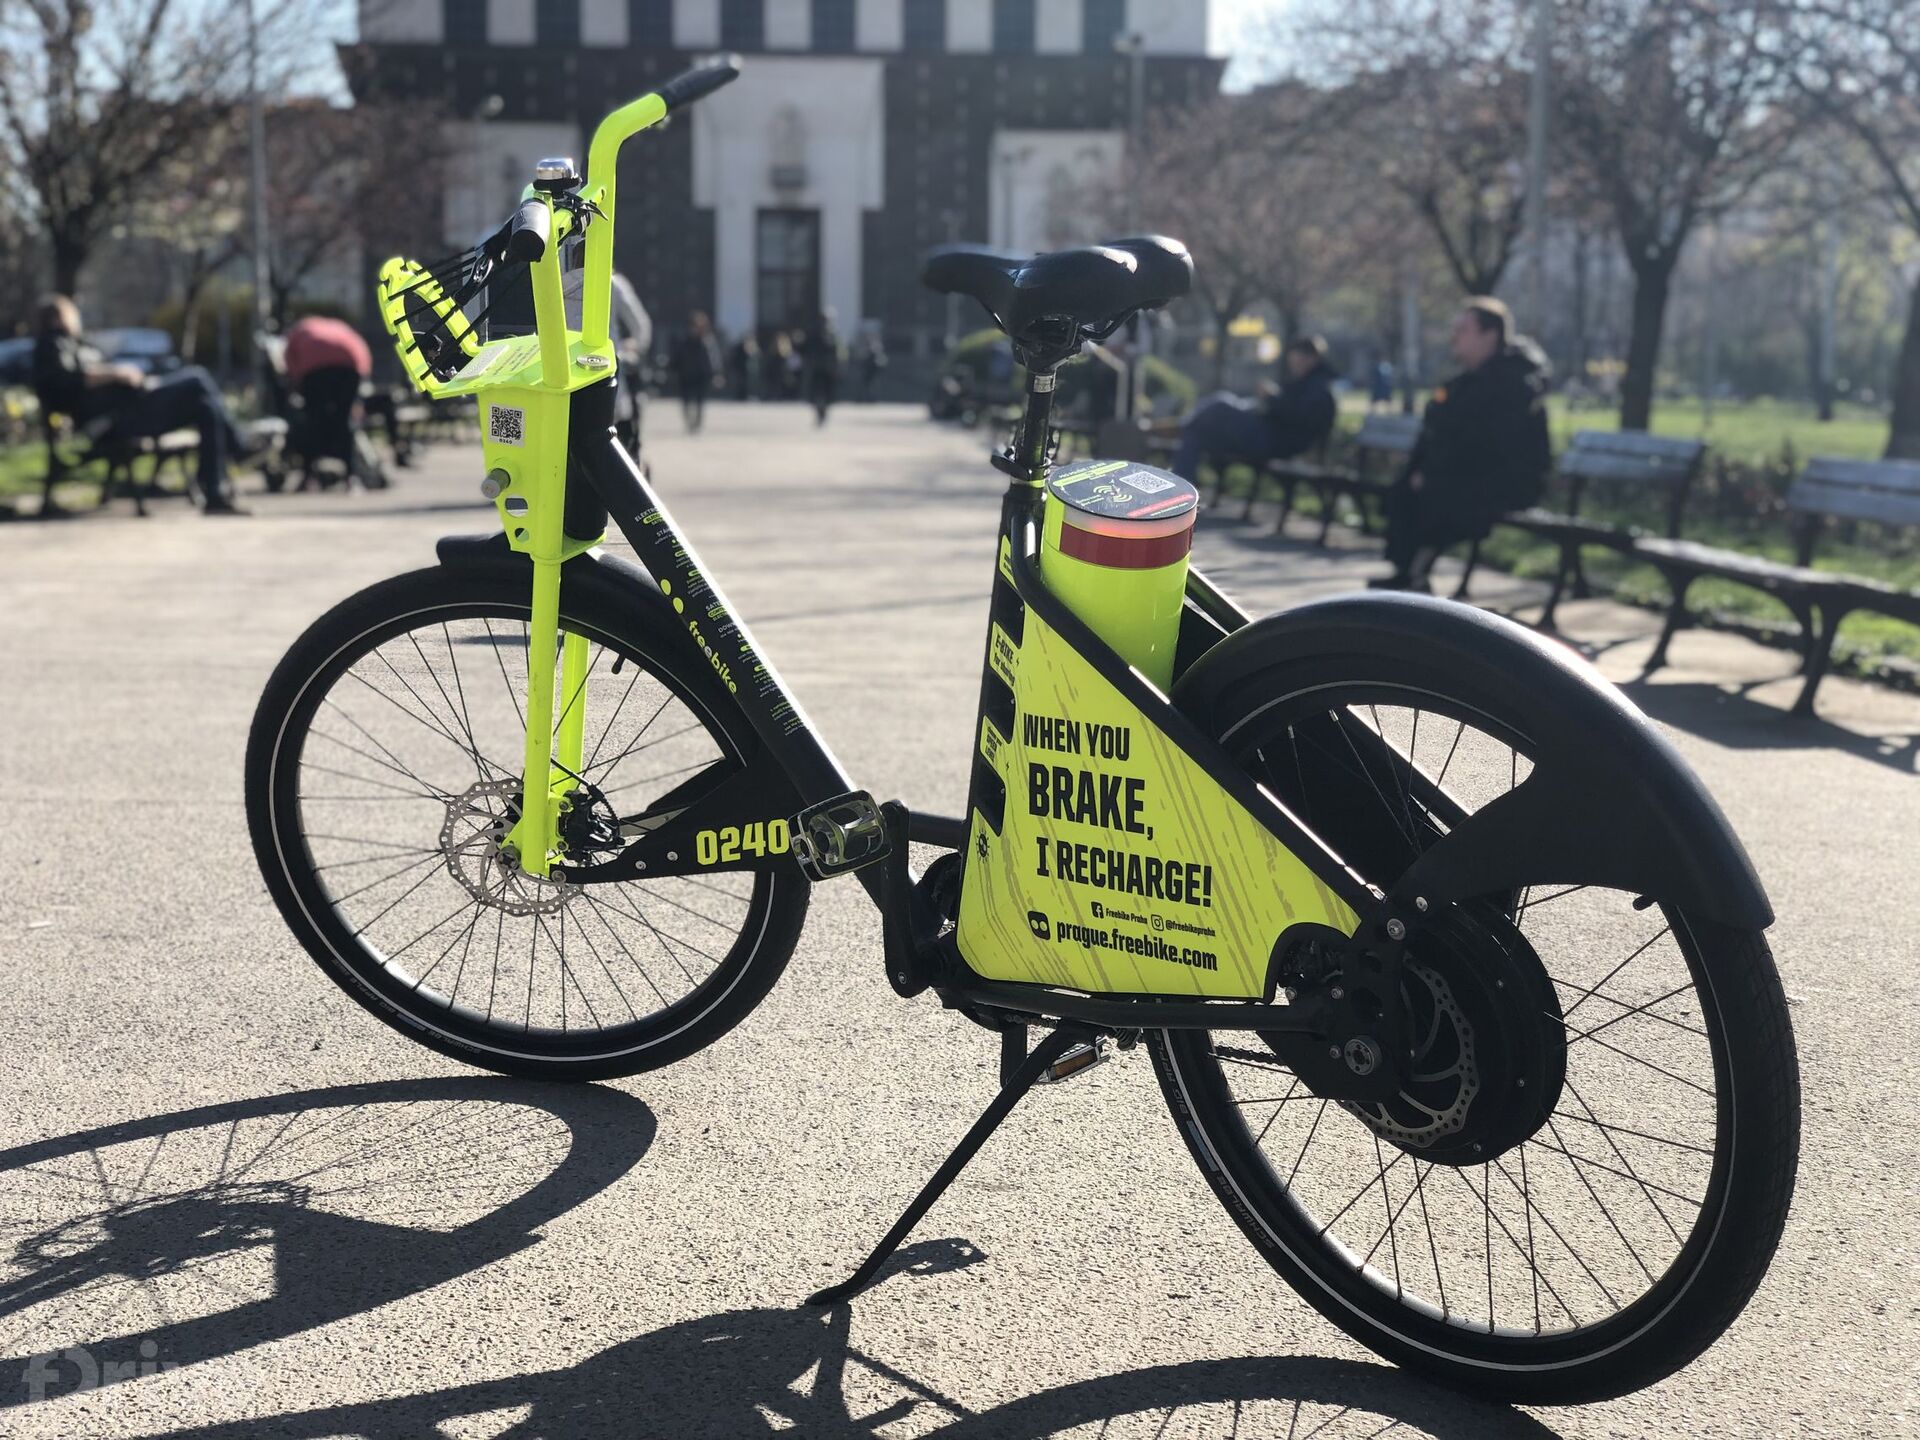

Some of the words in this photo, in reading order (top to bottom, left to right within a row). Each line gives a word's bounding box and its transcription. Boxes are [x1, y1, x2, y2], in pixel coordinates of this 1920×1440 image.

[689, 620, 737, 694] freebike
[1023, 712, 1081, 755] WHEN
[1085, 722, 1130, 762] YOU
[1028, 761, 1154, 841] BRAKE,
[696, 818, 790, 866] 0240
[1036, 836, 1049, 877] I
[1056, 839, 1212, 908] RECHARGE!
[1105, 908, 1130, 921] Freebike
[1057, 921, 1218, 972] prague.freebike.com
[1217, 1173, 1276, 1250] SCHWALBE
